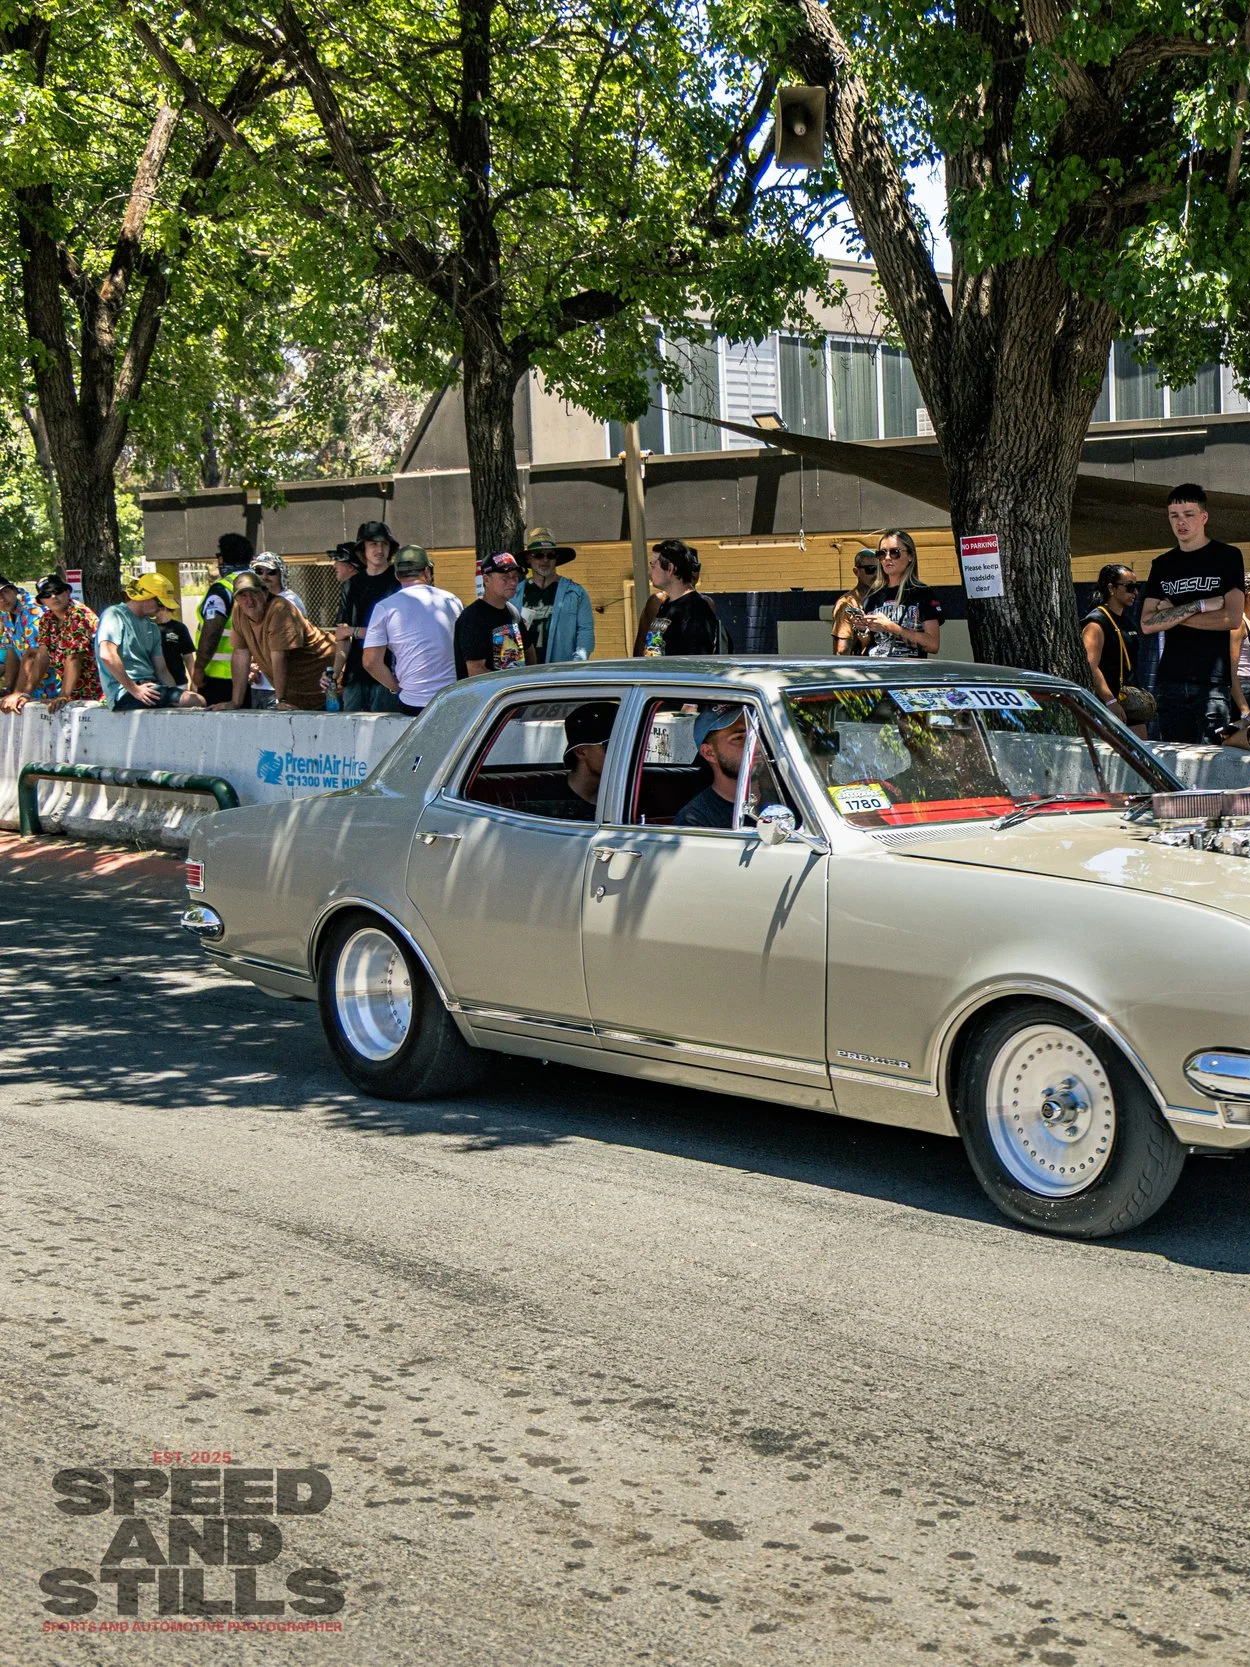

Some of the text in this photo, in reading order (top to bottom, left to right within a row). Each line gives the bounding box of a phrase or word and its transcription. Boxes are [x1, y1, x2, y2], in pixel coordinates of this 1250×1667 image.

[970, 540, 998, 549] PARKING
[964, 564, 982, 572] Please
[969, 573, 995, 582] roadside
[970, 690, 1023, 707] 1780
[285, 752, 368, 777] PremiAir Hire
[296, 774, 365, 789] 1300 WE HIR
[845, 798, 881, 811] 1780
[836, 1049, 911, 1069] PREMIER
